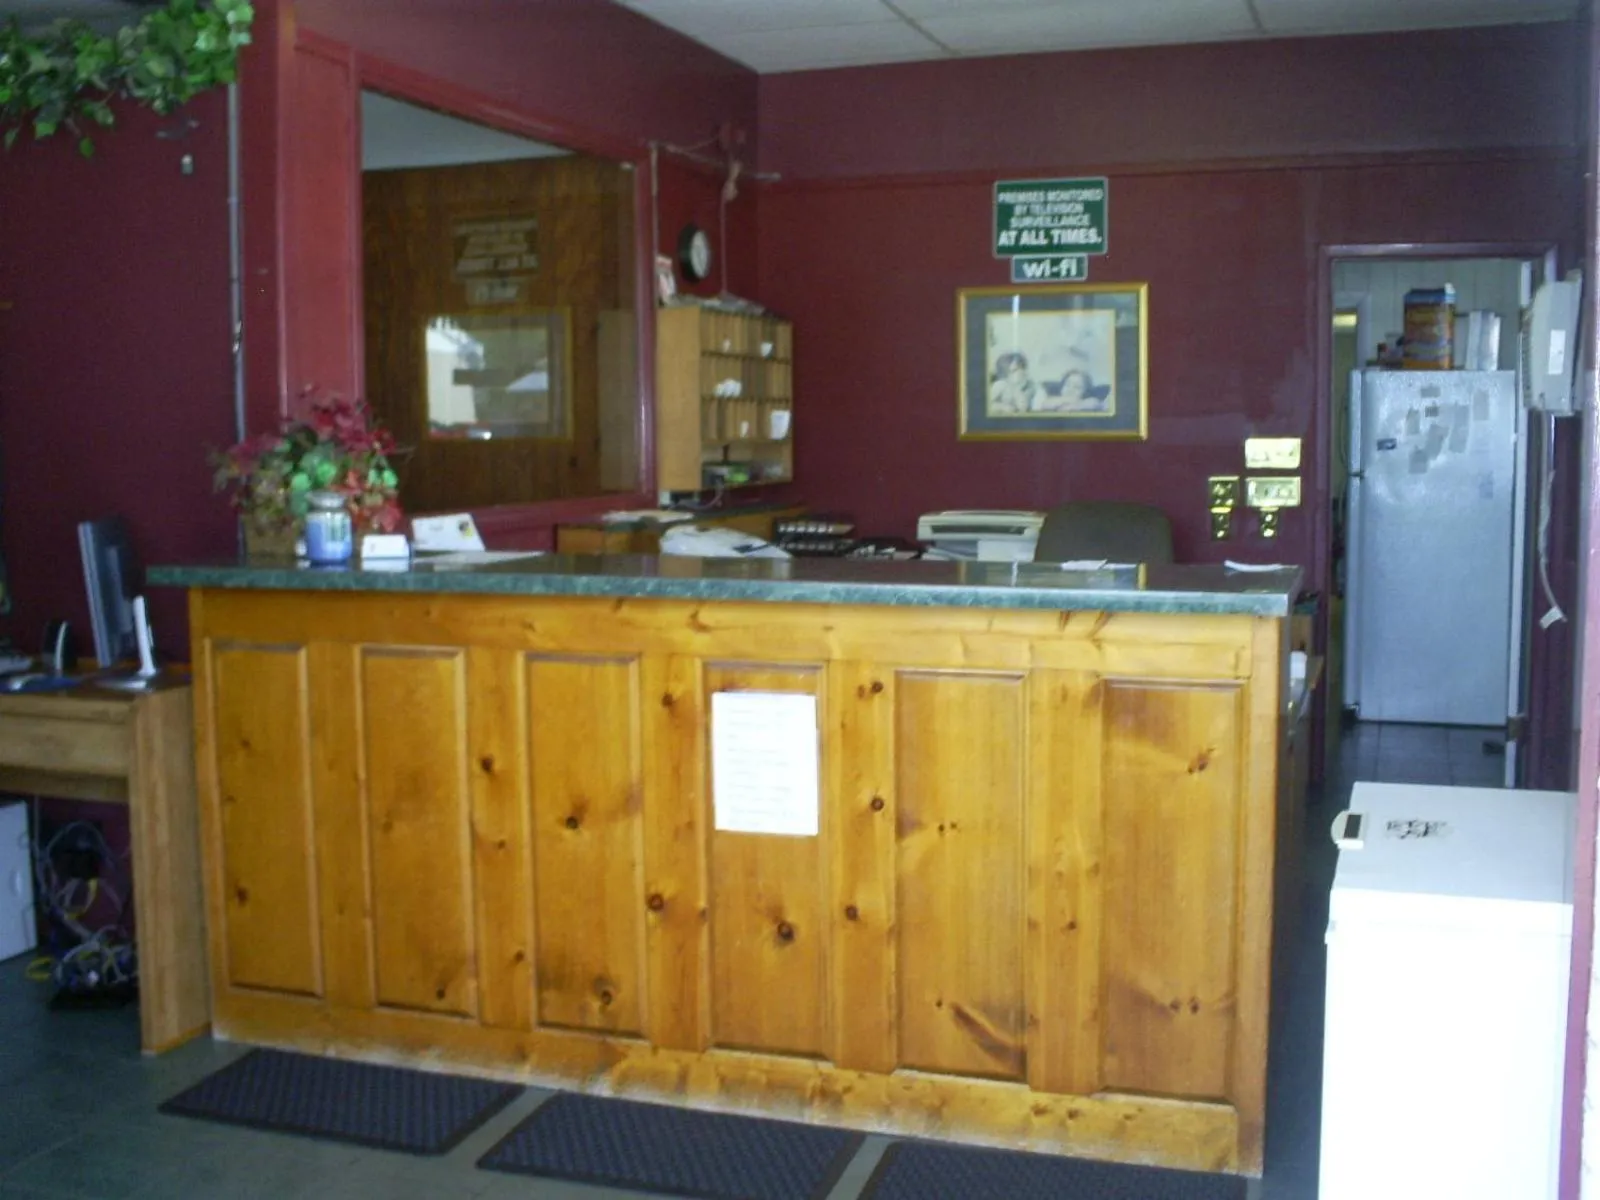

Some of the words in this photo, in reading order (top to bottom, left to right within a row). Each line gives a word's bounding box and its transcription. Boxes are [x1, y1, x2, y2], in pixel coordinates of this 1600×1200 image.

[1010, 214, 1090, 228] SURVEILLANCE
[998, 230, 1018, 246] AT
[1019, 229, 1048, 246] ALL
[1050, 227, 1102, 244] TIMES.
[1022, 258, 1077, 277] wi-fi
